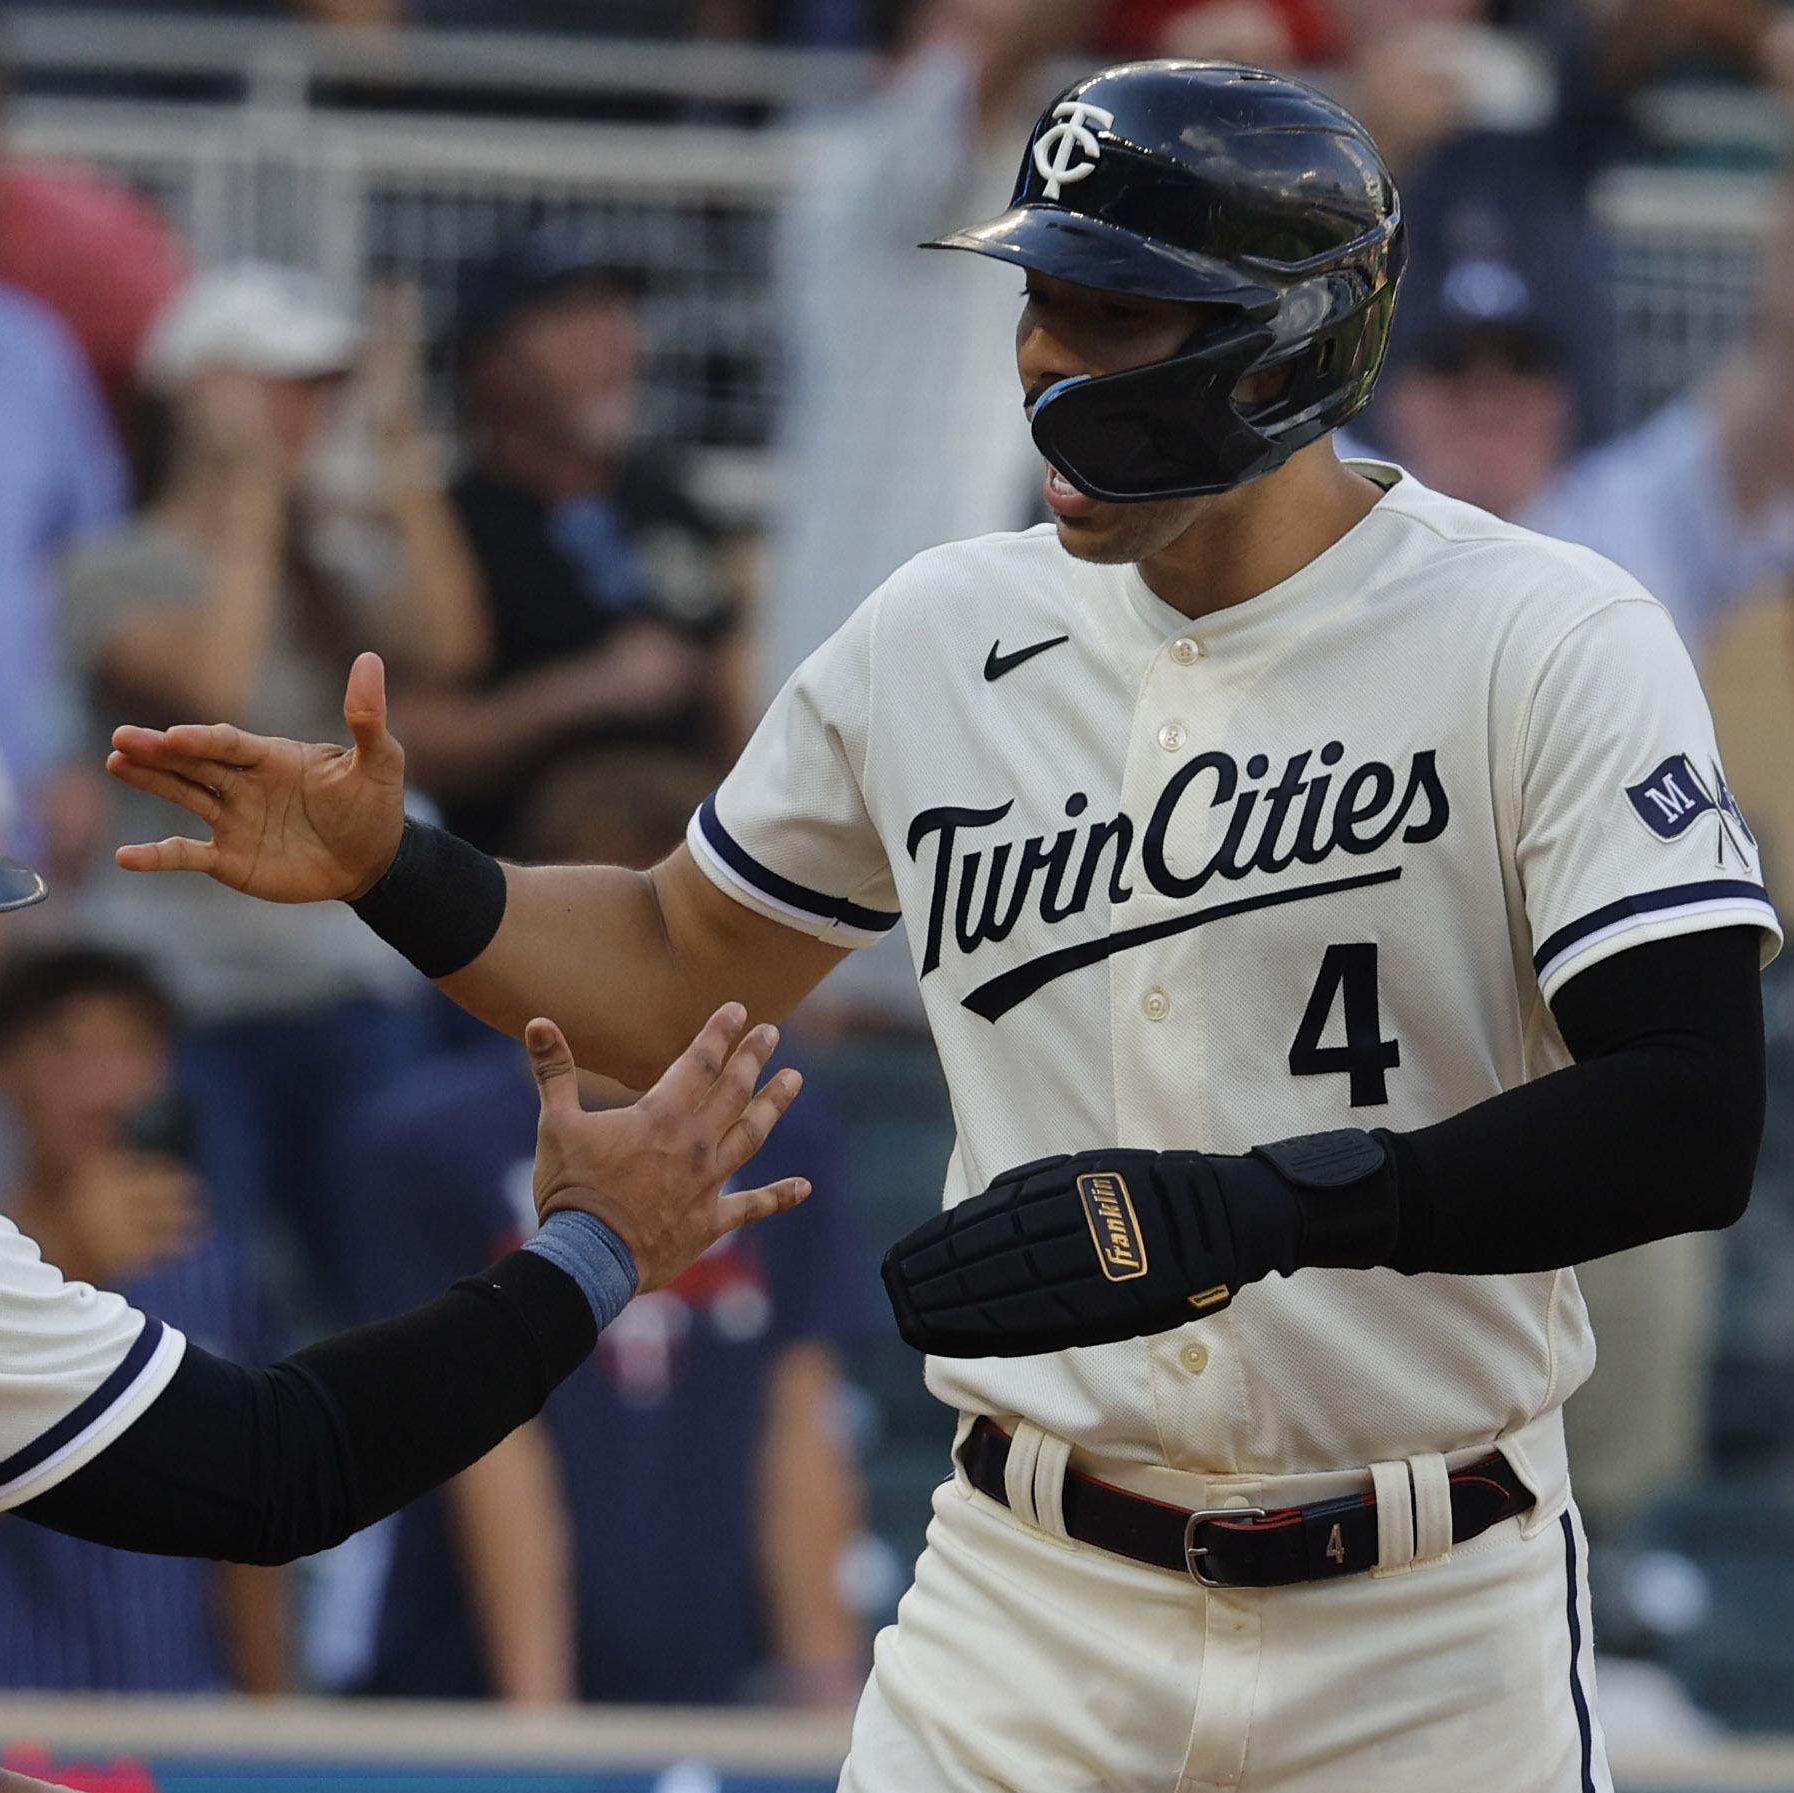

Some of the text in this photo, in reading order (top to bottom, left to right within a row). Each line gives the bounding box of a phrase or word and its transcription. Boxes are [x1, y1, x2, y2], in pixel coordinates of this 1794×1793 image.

[1644, 772, 1696, 824] M
[906, 740, 1450, 981] Twin Cities
[1288, 942, 1400, 1107] 4
[1326, 1522, 1345, 1564] 4
